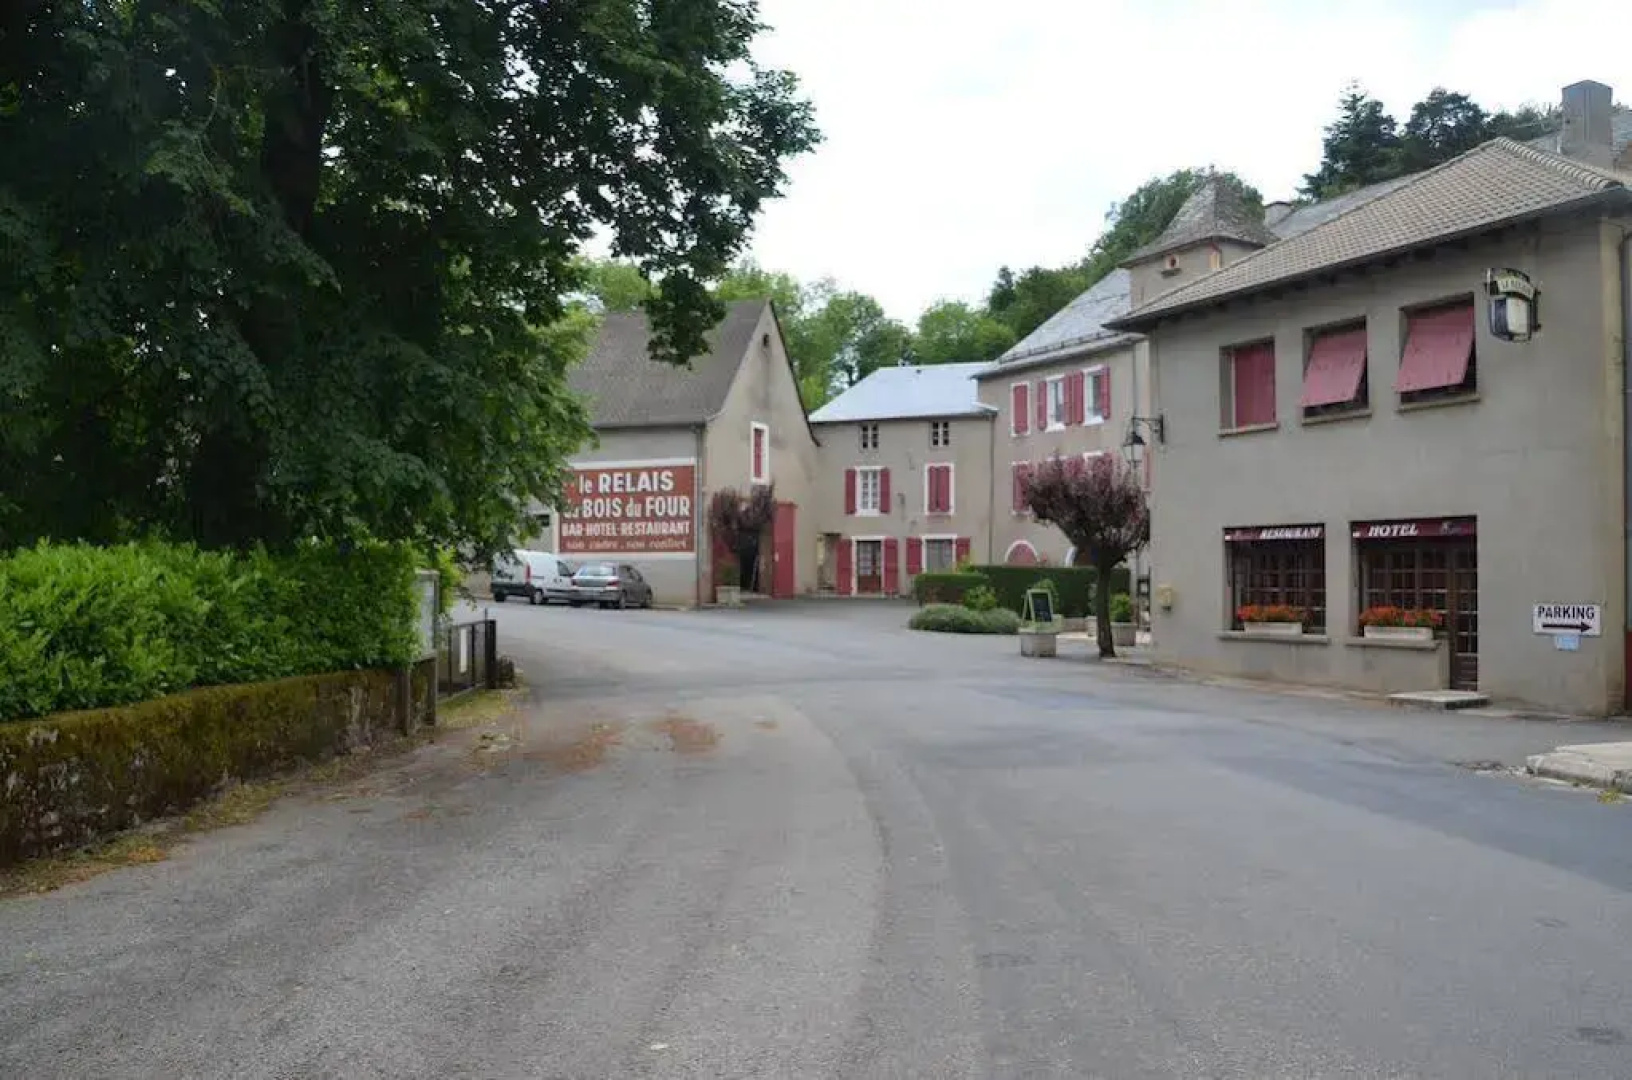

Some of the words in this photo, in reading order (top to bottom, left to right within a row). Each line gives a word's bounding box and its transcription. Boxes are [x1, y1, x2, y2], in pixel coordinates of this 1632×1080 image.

[579, 474, 592, 493] le
[598, 471, 674, 493] RELAIS
[583, 497, 622, 518] BOIS
[625, 497, 642, 518] du
[646, 495, 690, 517] FOUR
[1368, 522, 1419, 537] HOTEL
[1537, 605, 1595, 620] PARKING
